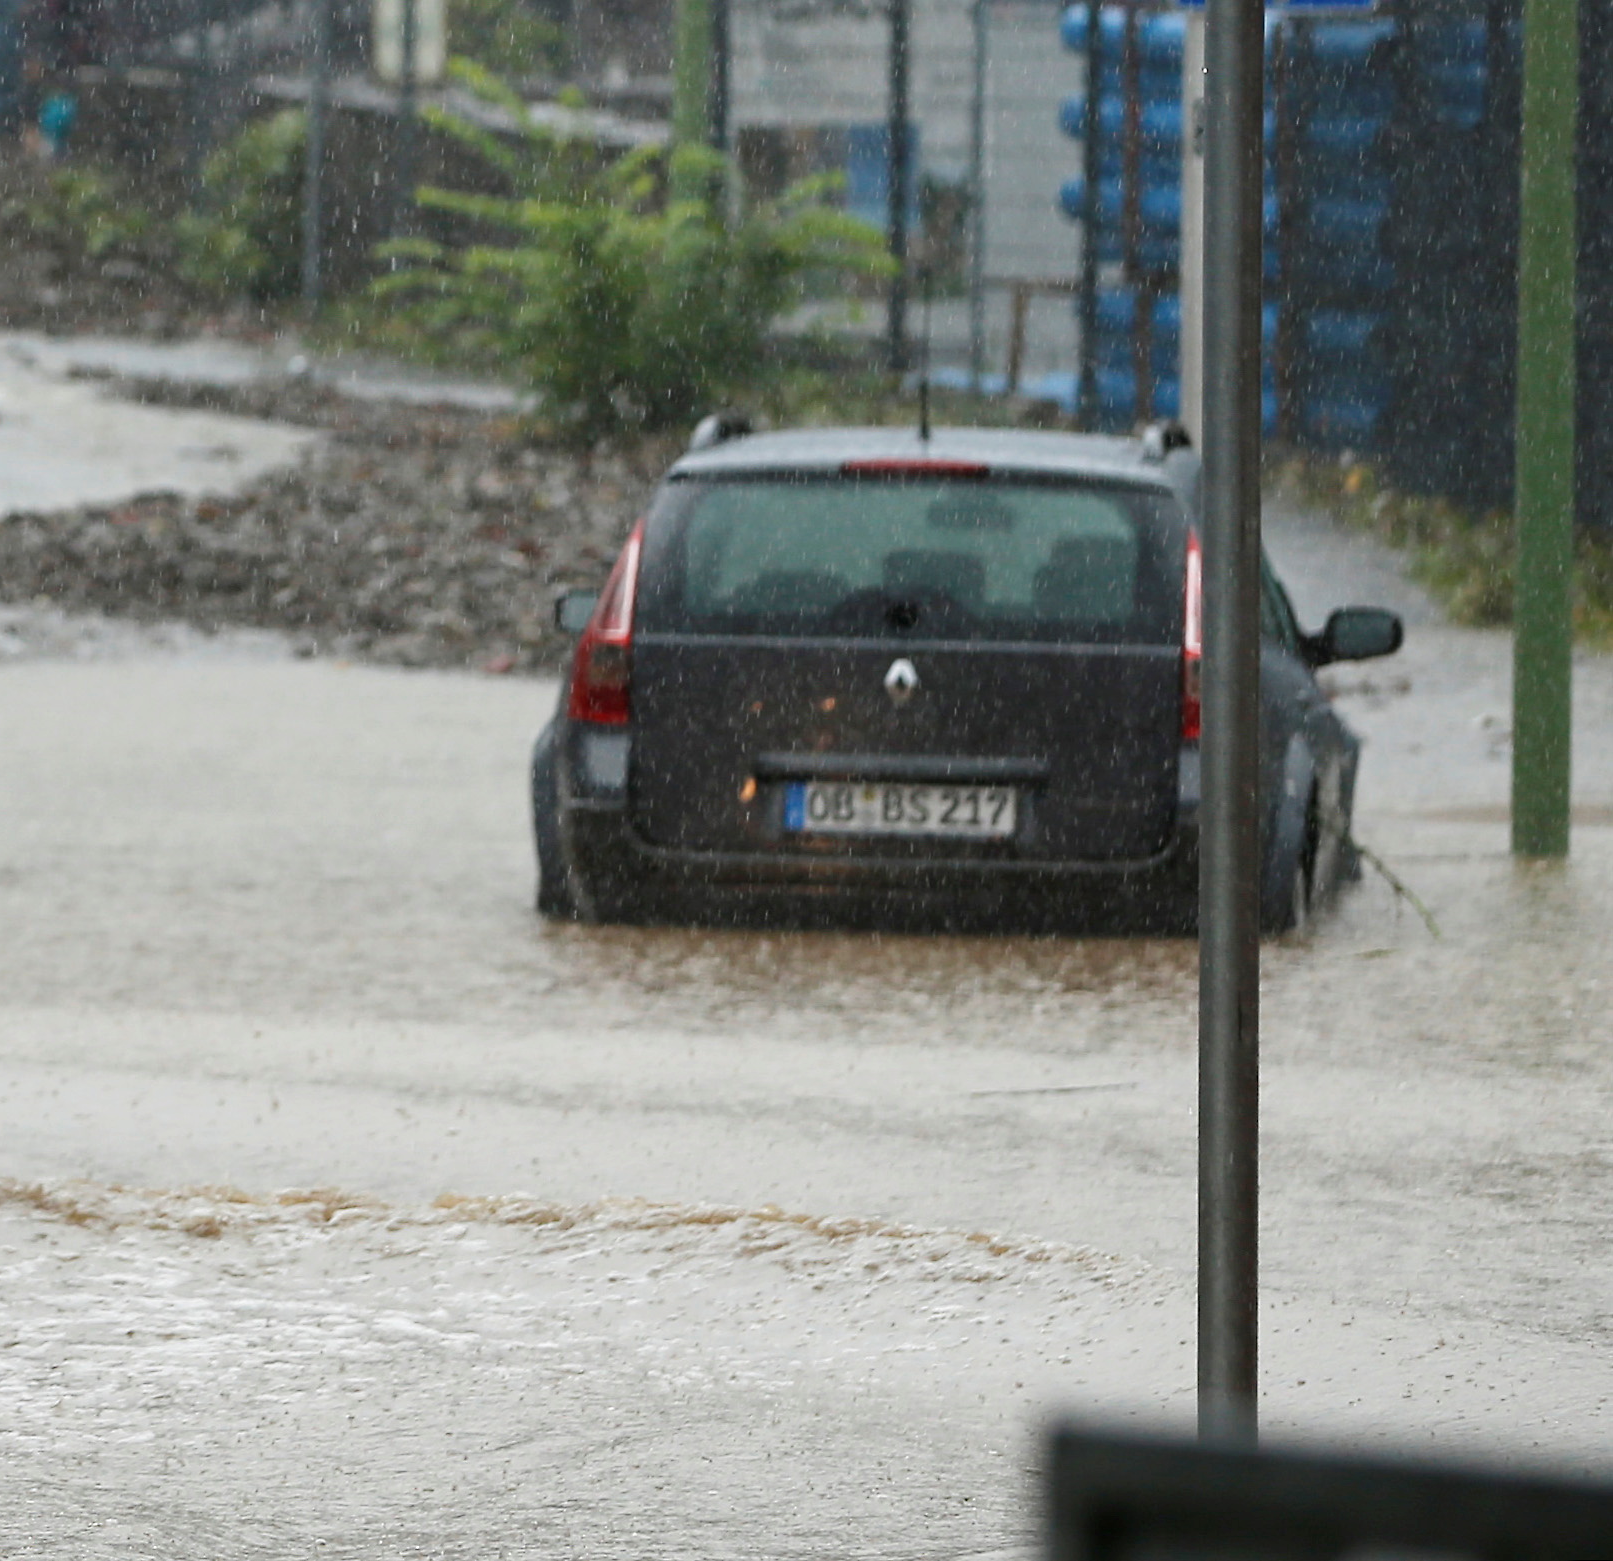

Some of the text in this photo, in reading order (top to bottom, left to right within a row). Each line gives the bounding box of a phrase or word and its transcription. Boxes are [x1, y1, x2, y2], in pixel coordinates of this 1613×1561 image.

[809, 787, 1007, 826] OB BS 217
